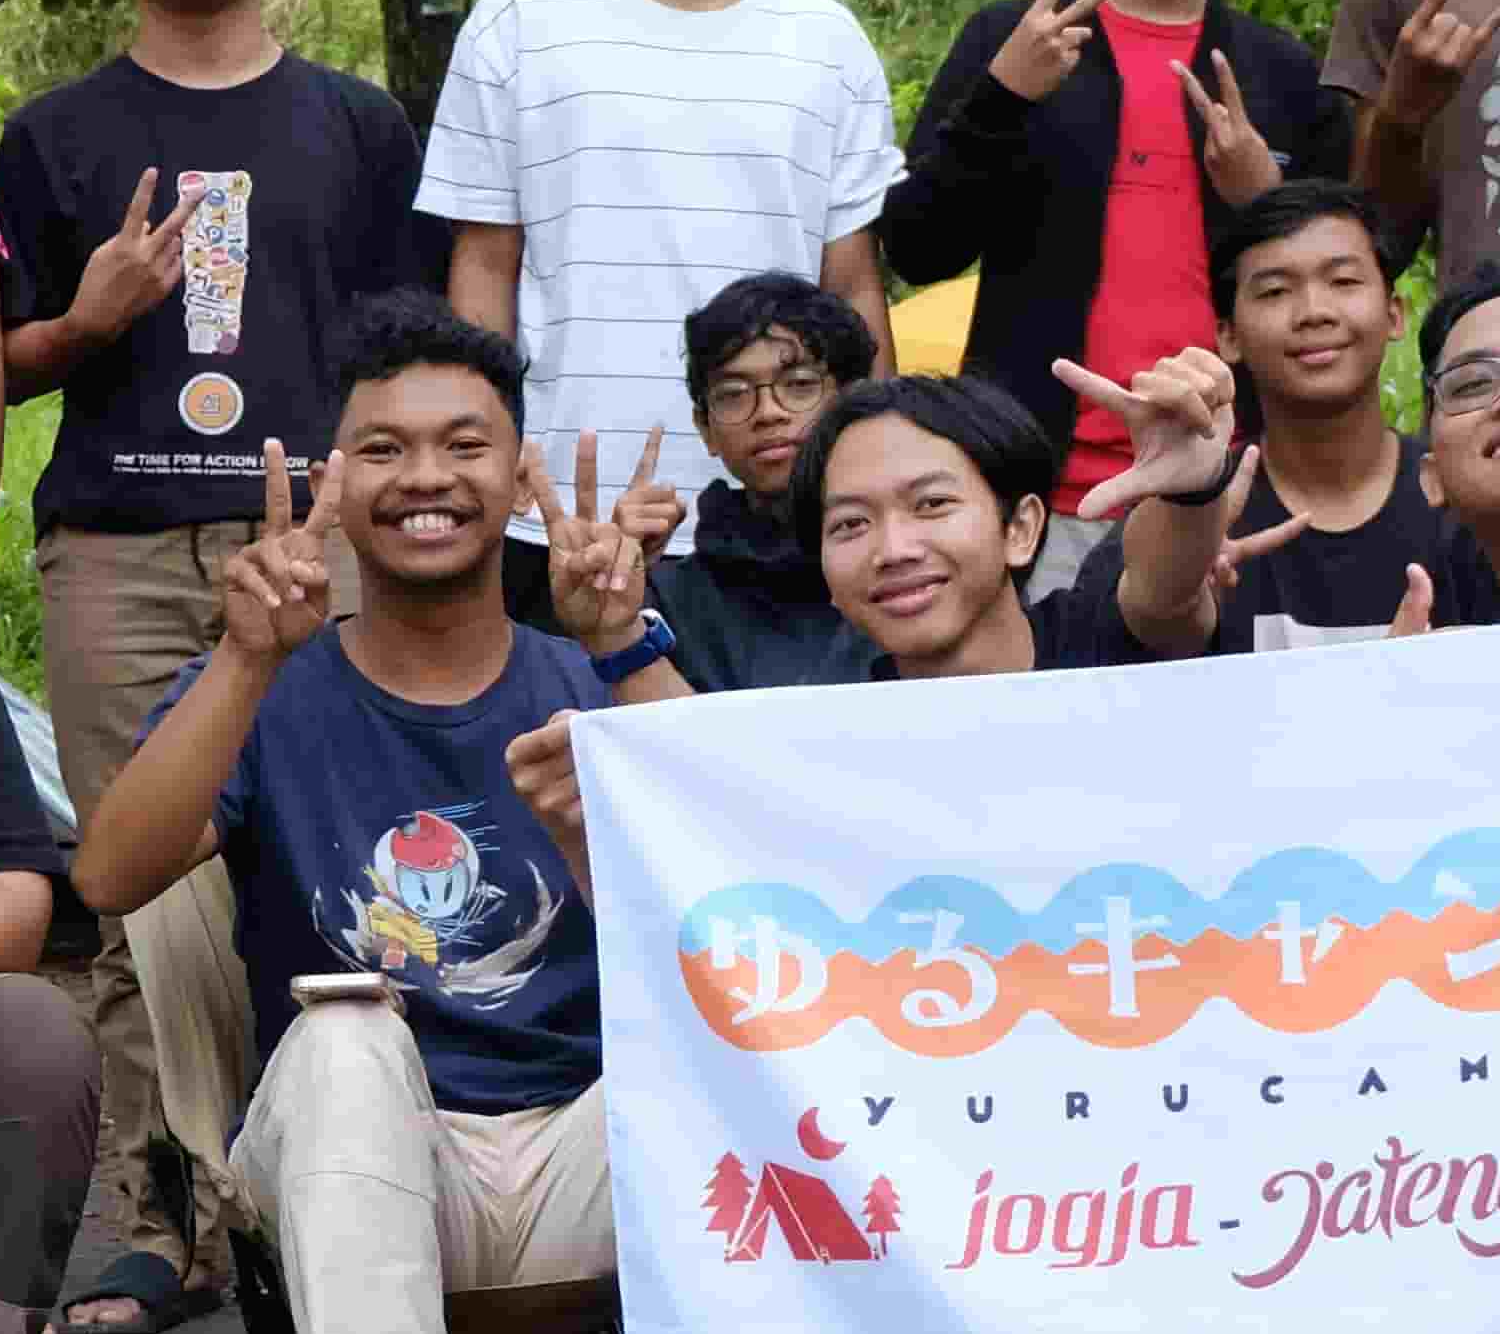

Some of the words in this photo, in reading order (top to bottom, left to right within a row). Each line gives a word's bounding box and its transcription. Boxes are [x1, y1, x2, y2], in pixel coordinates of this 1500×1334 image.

[138, 454, 170, 467] TIME
[173, 454, 202, 467] FOR
[204, 455, 258, 468] ACTION
